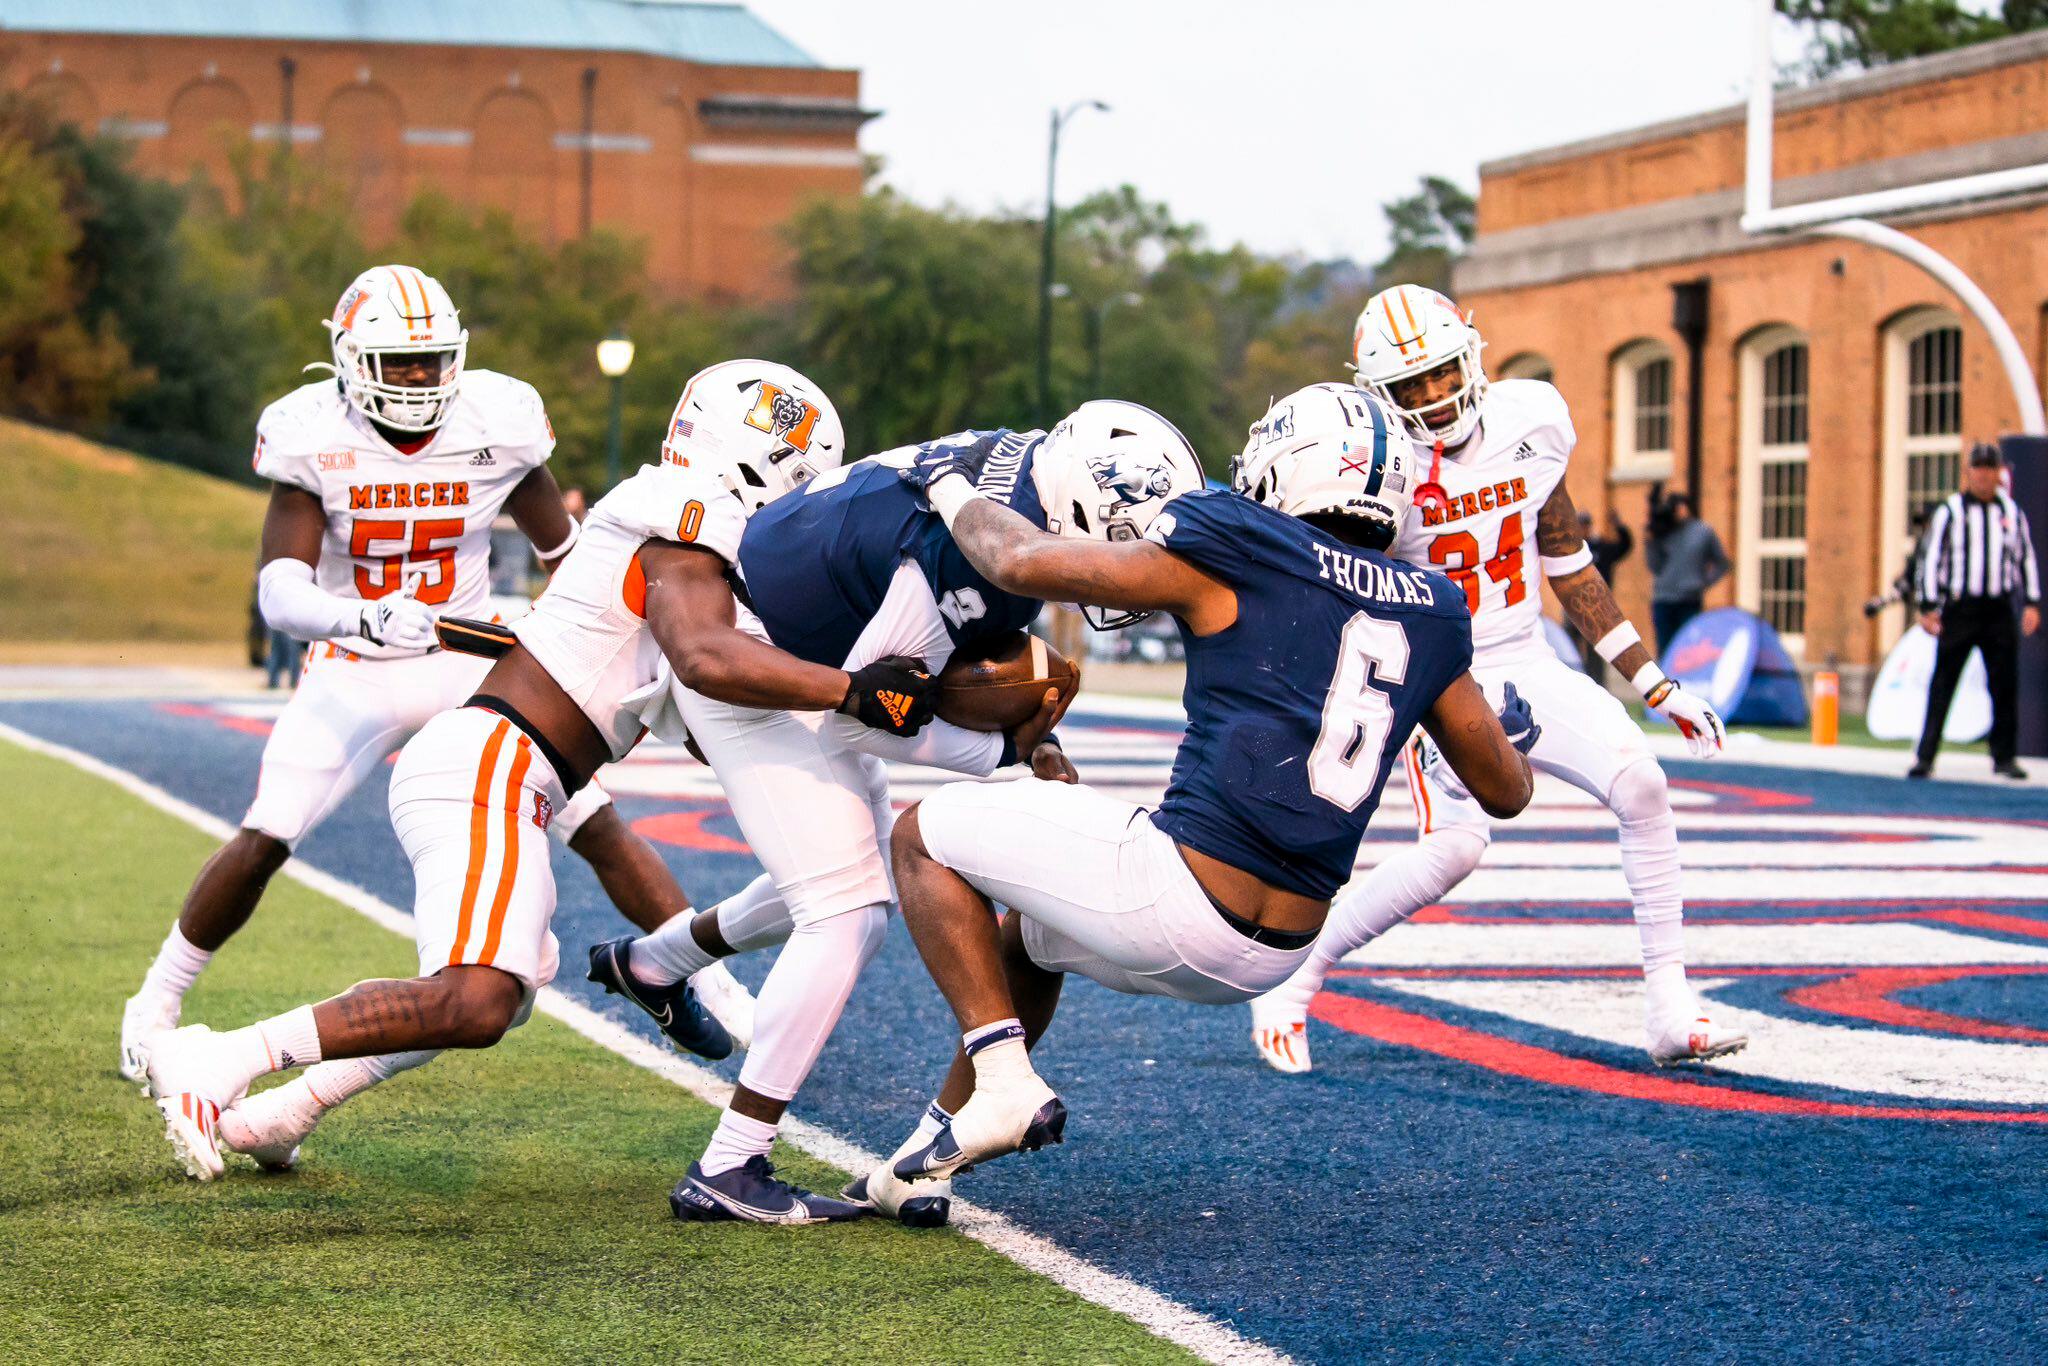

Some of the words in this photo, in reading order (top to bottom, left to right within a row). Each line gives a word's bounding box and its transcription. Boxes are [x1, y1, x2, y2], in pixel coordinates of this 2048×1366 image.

[1394, 456, 1401, 471] 6
[350, 482, 469, 509] MERCER
[1423, 477, 1528, 526] MERCER
[677, 499, 705, 543] 0
[351, 518, 465, 606] 55
[1312, 541, 1435, 606] THOMAS
[1428, 513, 1525, 622] 34
[876, 689, 905, 727] adidas
[1307, 609, 1411, 813] 6
